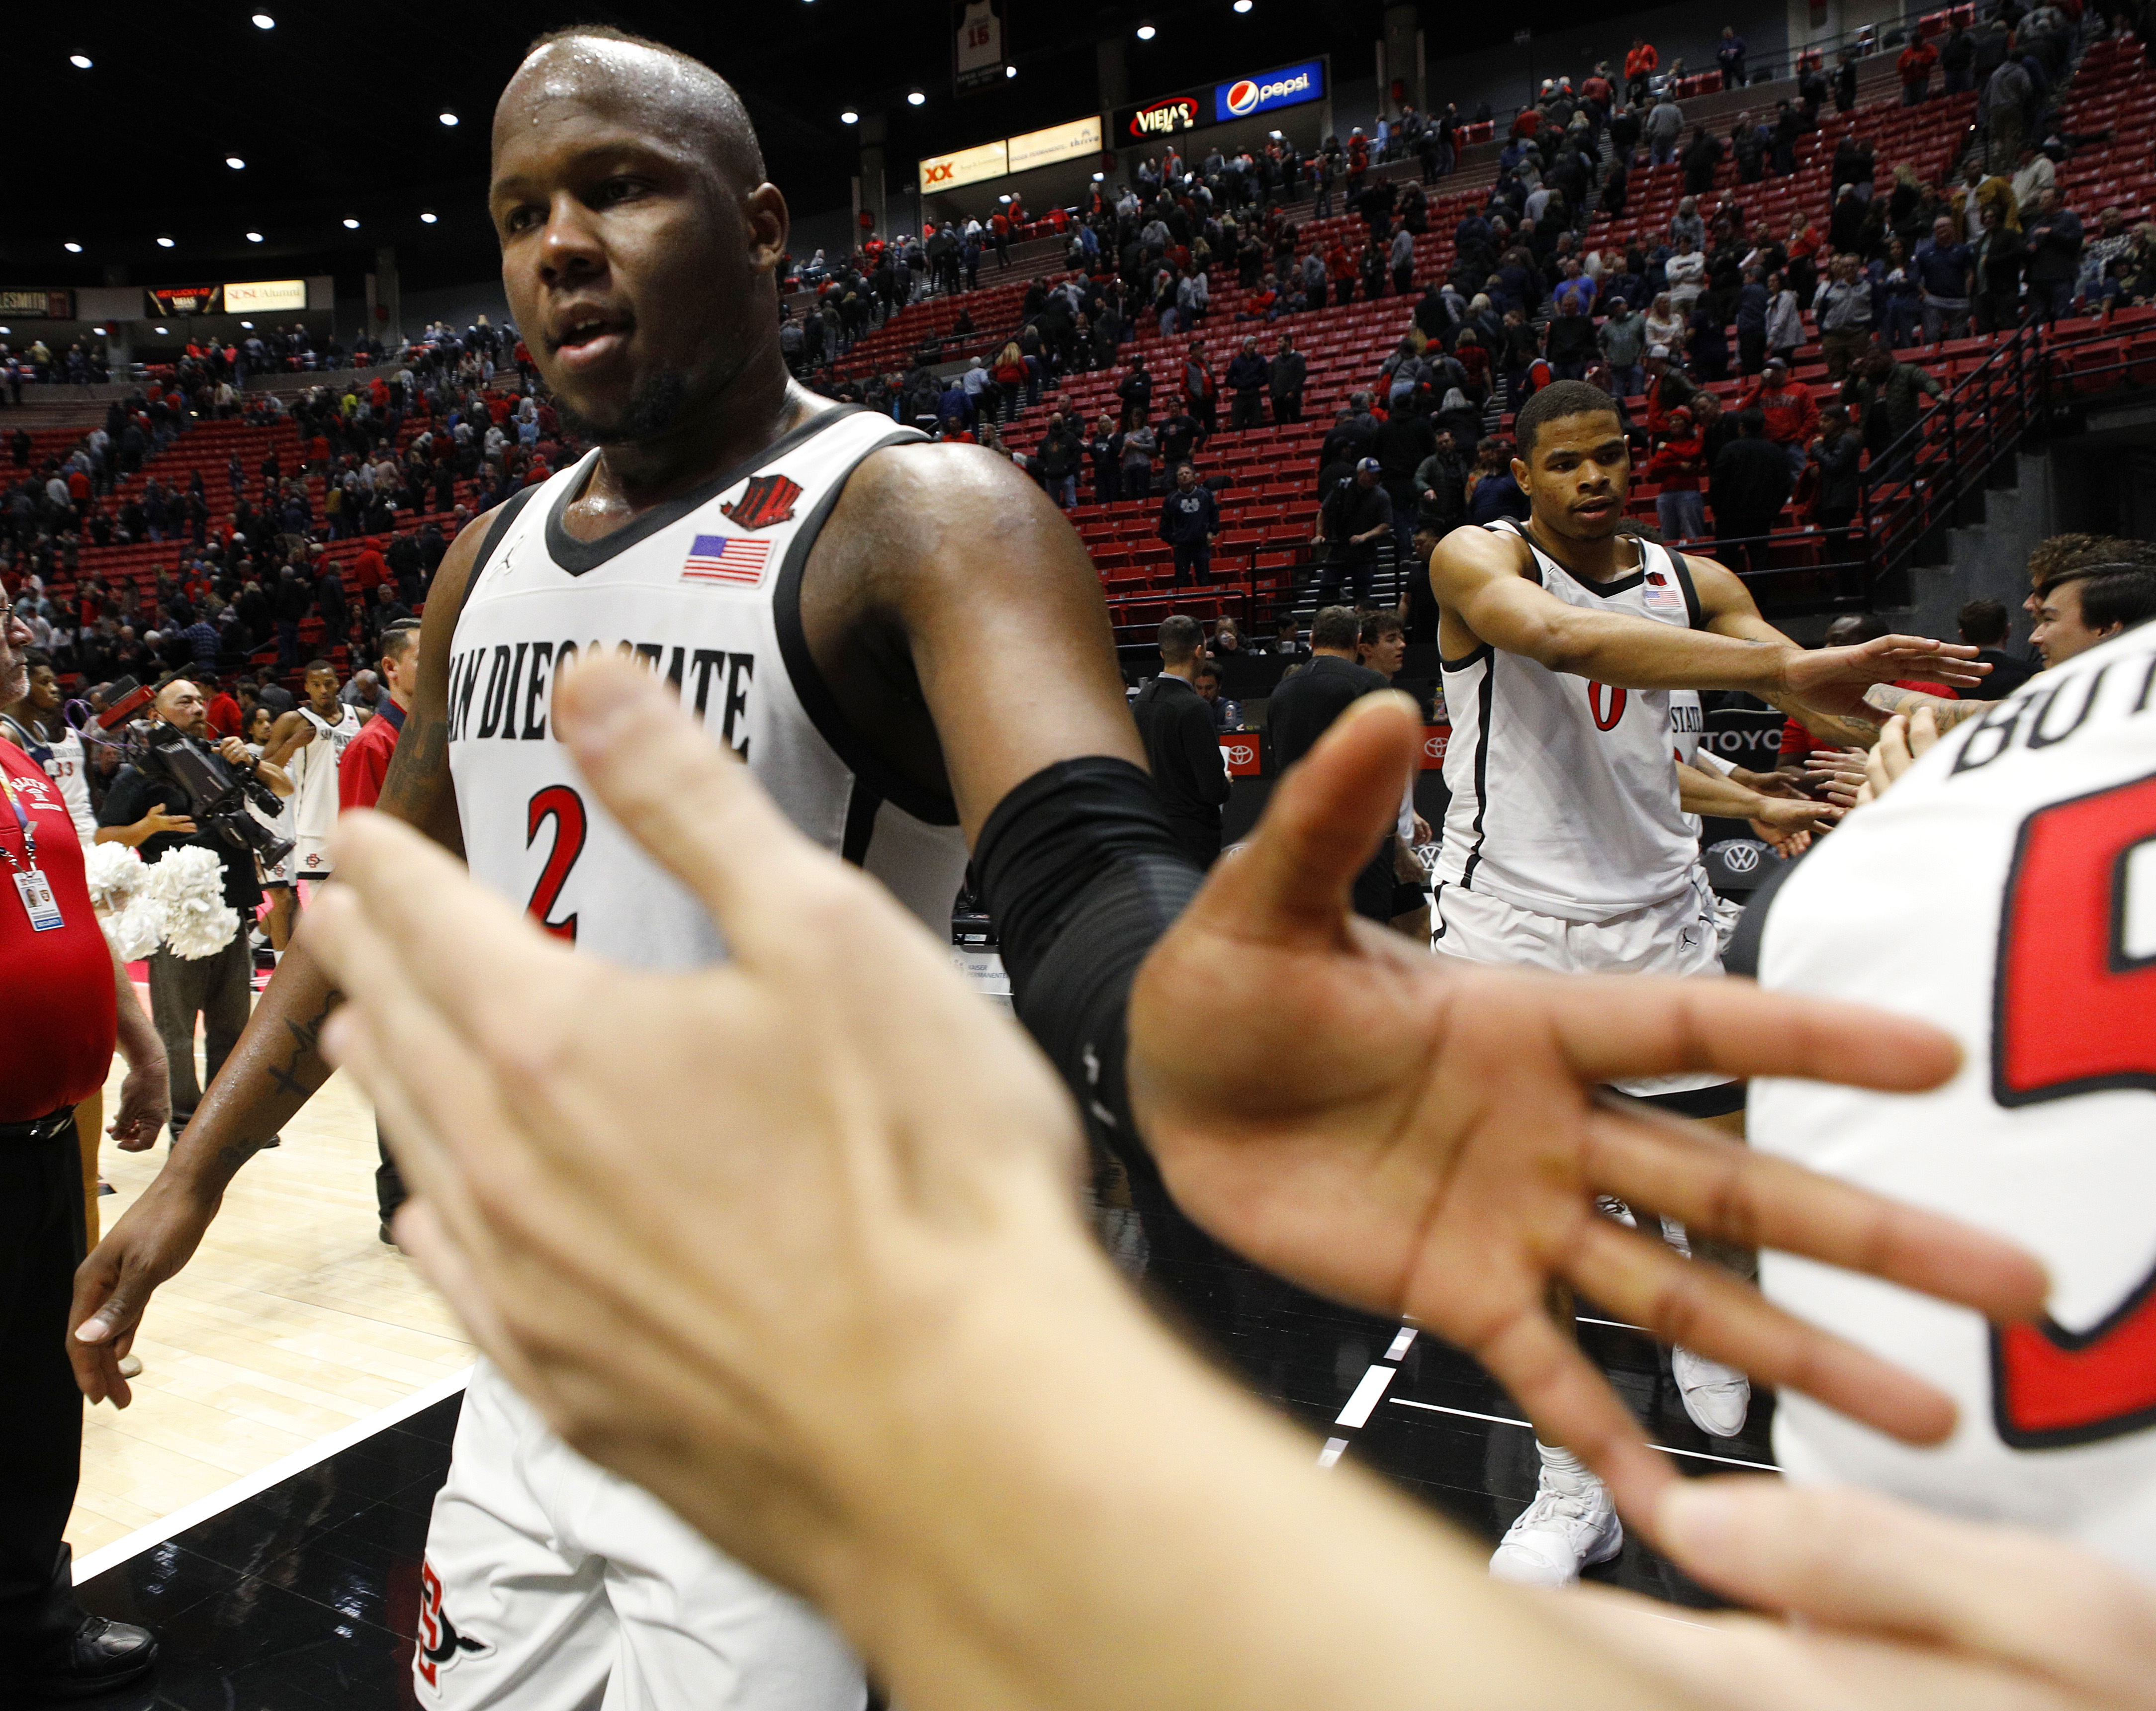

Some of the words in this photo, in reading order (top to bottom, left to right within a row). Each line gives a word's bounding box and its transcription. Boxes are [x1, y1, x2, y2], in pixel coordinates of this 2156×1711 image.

[1260, 73, 1310, 102] pepsi
[1136, 103, 1188, 133] VIEJAS
[526, 784, 587, 947] 2
